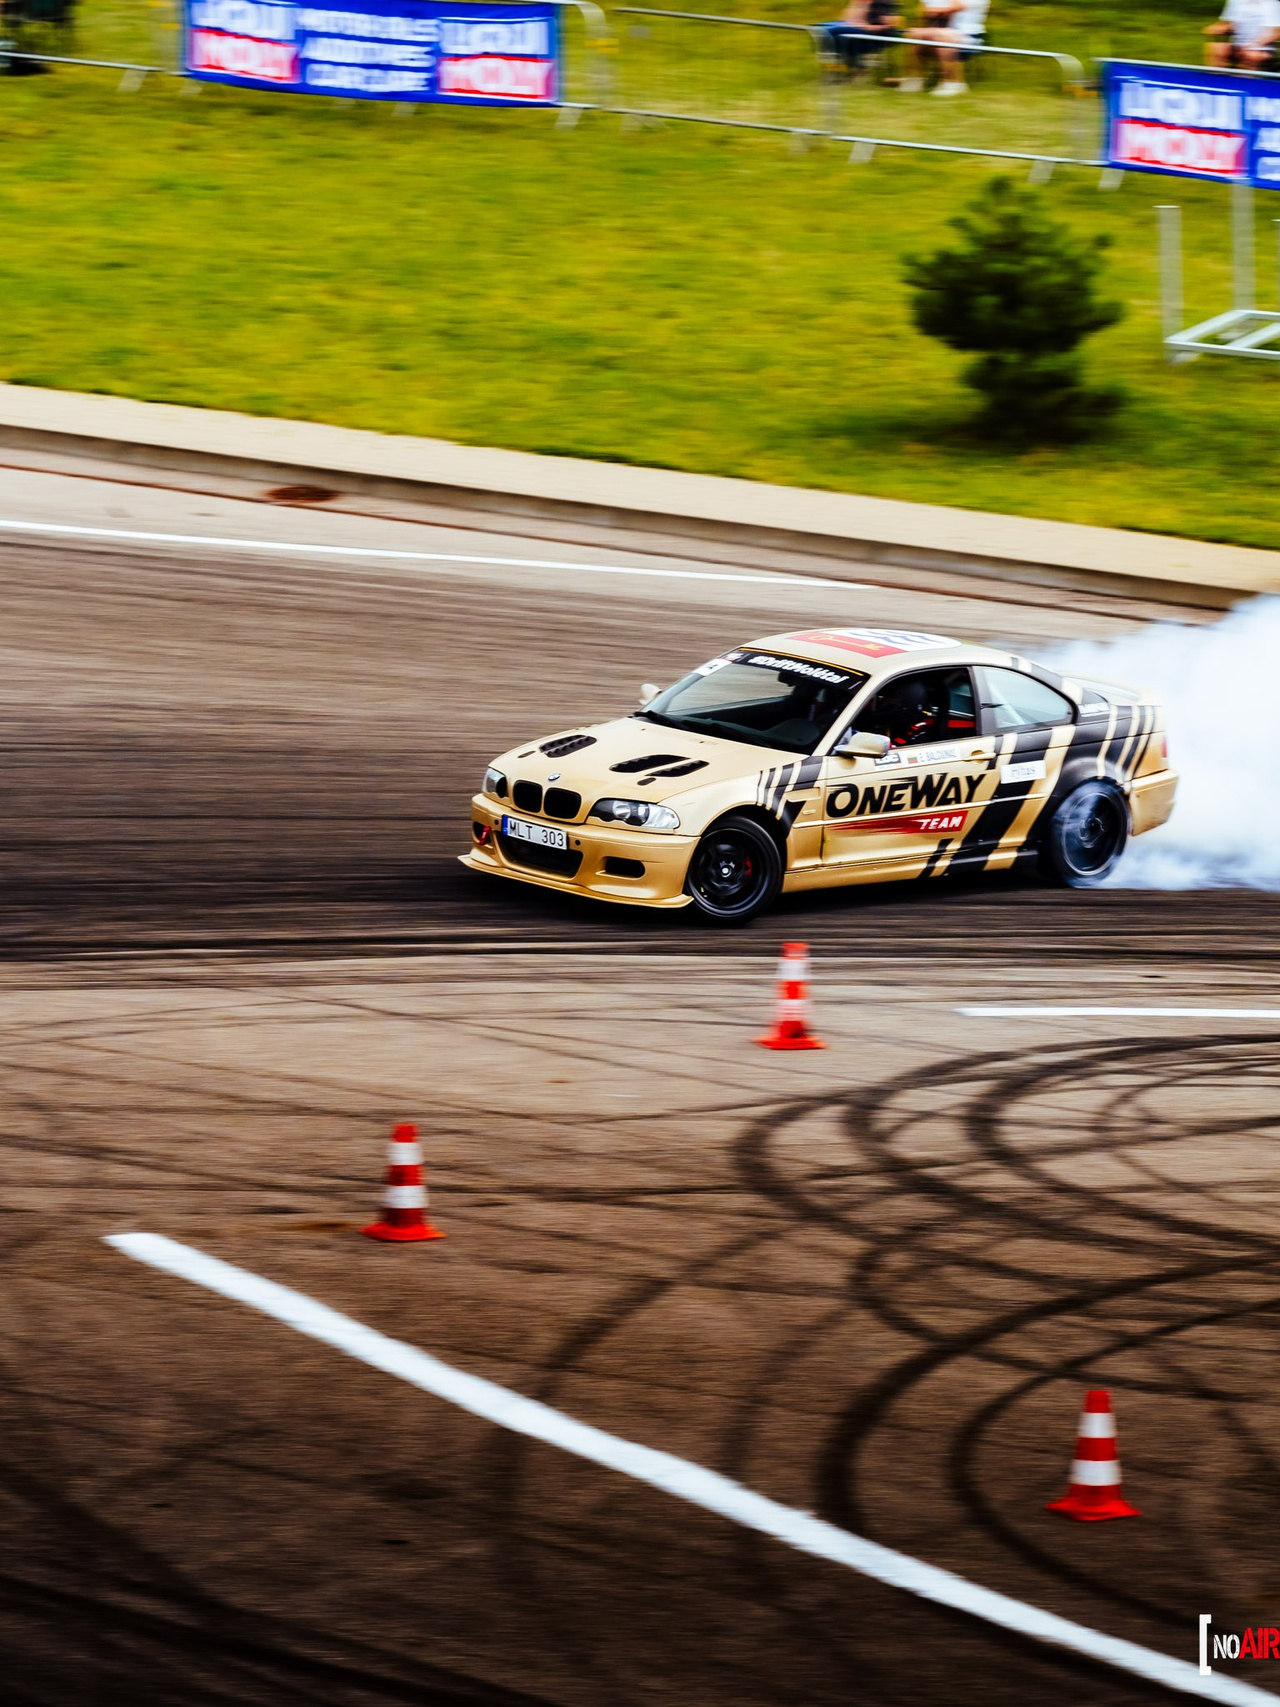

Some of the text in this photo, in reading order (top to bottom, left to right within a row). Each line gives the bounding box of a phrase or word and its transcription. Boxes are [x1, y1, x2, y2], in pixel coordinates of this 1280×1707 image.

[918, 816, 963, 830] TEAM
[509, 820, 564, 847] MLT 303
